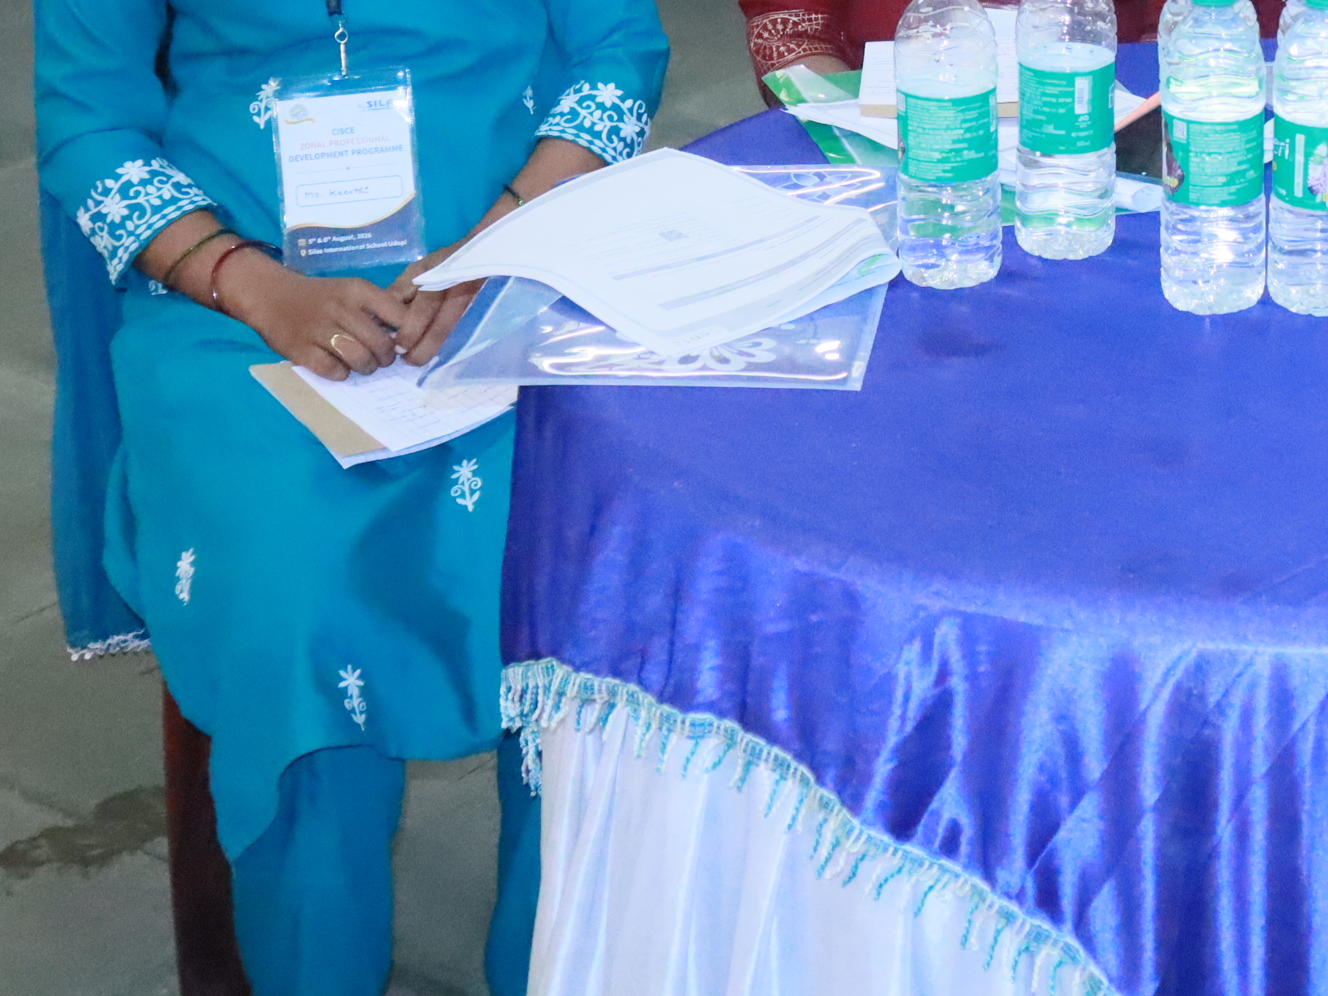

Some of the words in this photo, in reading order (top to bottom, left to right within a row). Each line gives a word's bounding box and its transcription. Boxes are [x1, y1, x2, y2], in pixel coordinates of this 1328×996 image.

[332, 126, 355, 136] CISCE
[300, 141, 326, 150] ZONAL
[328, 134, 390, 148] PROFESSIONAL
[288, 150, 350, 162] DEVELOPMENT
[351, 144, 404, 156] PROGRAMME
